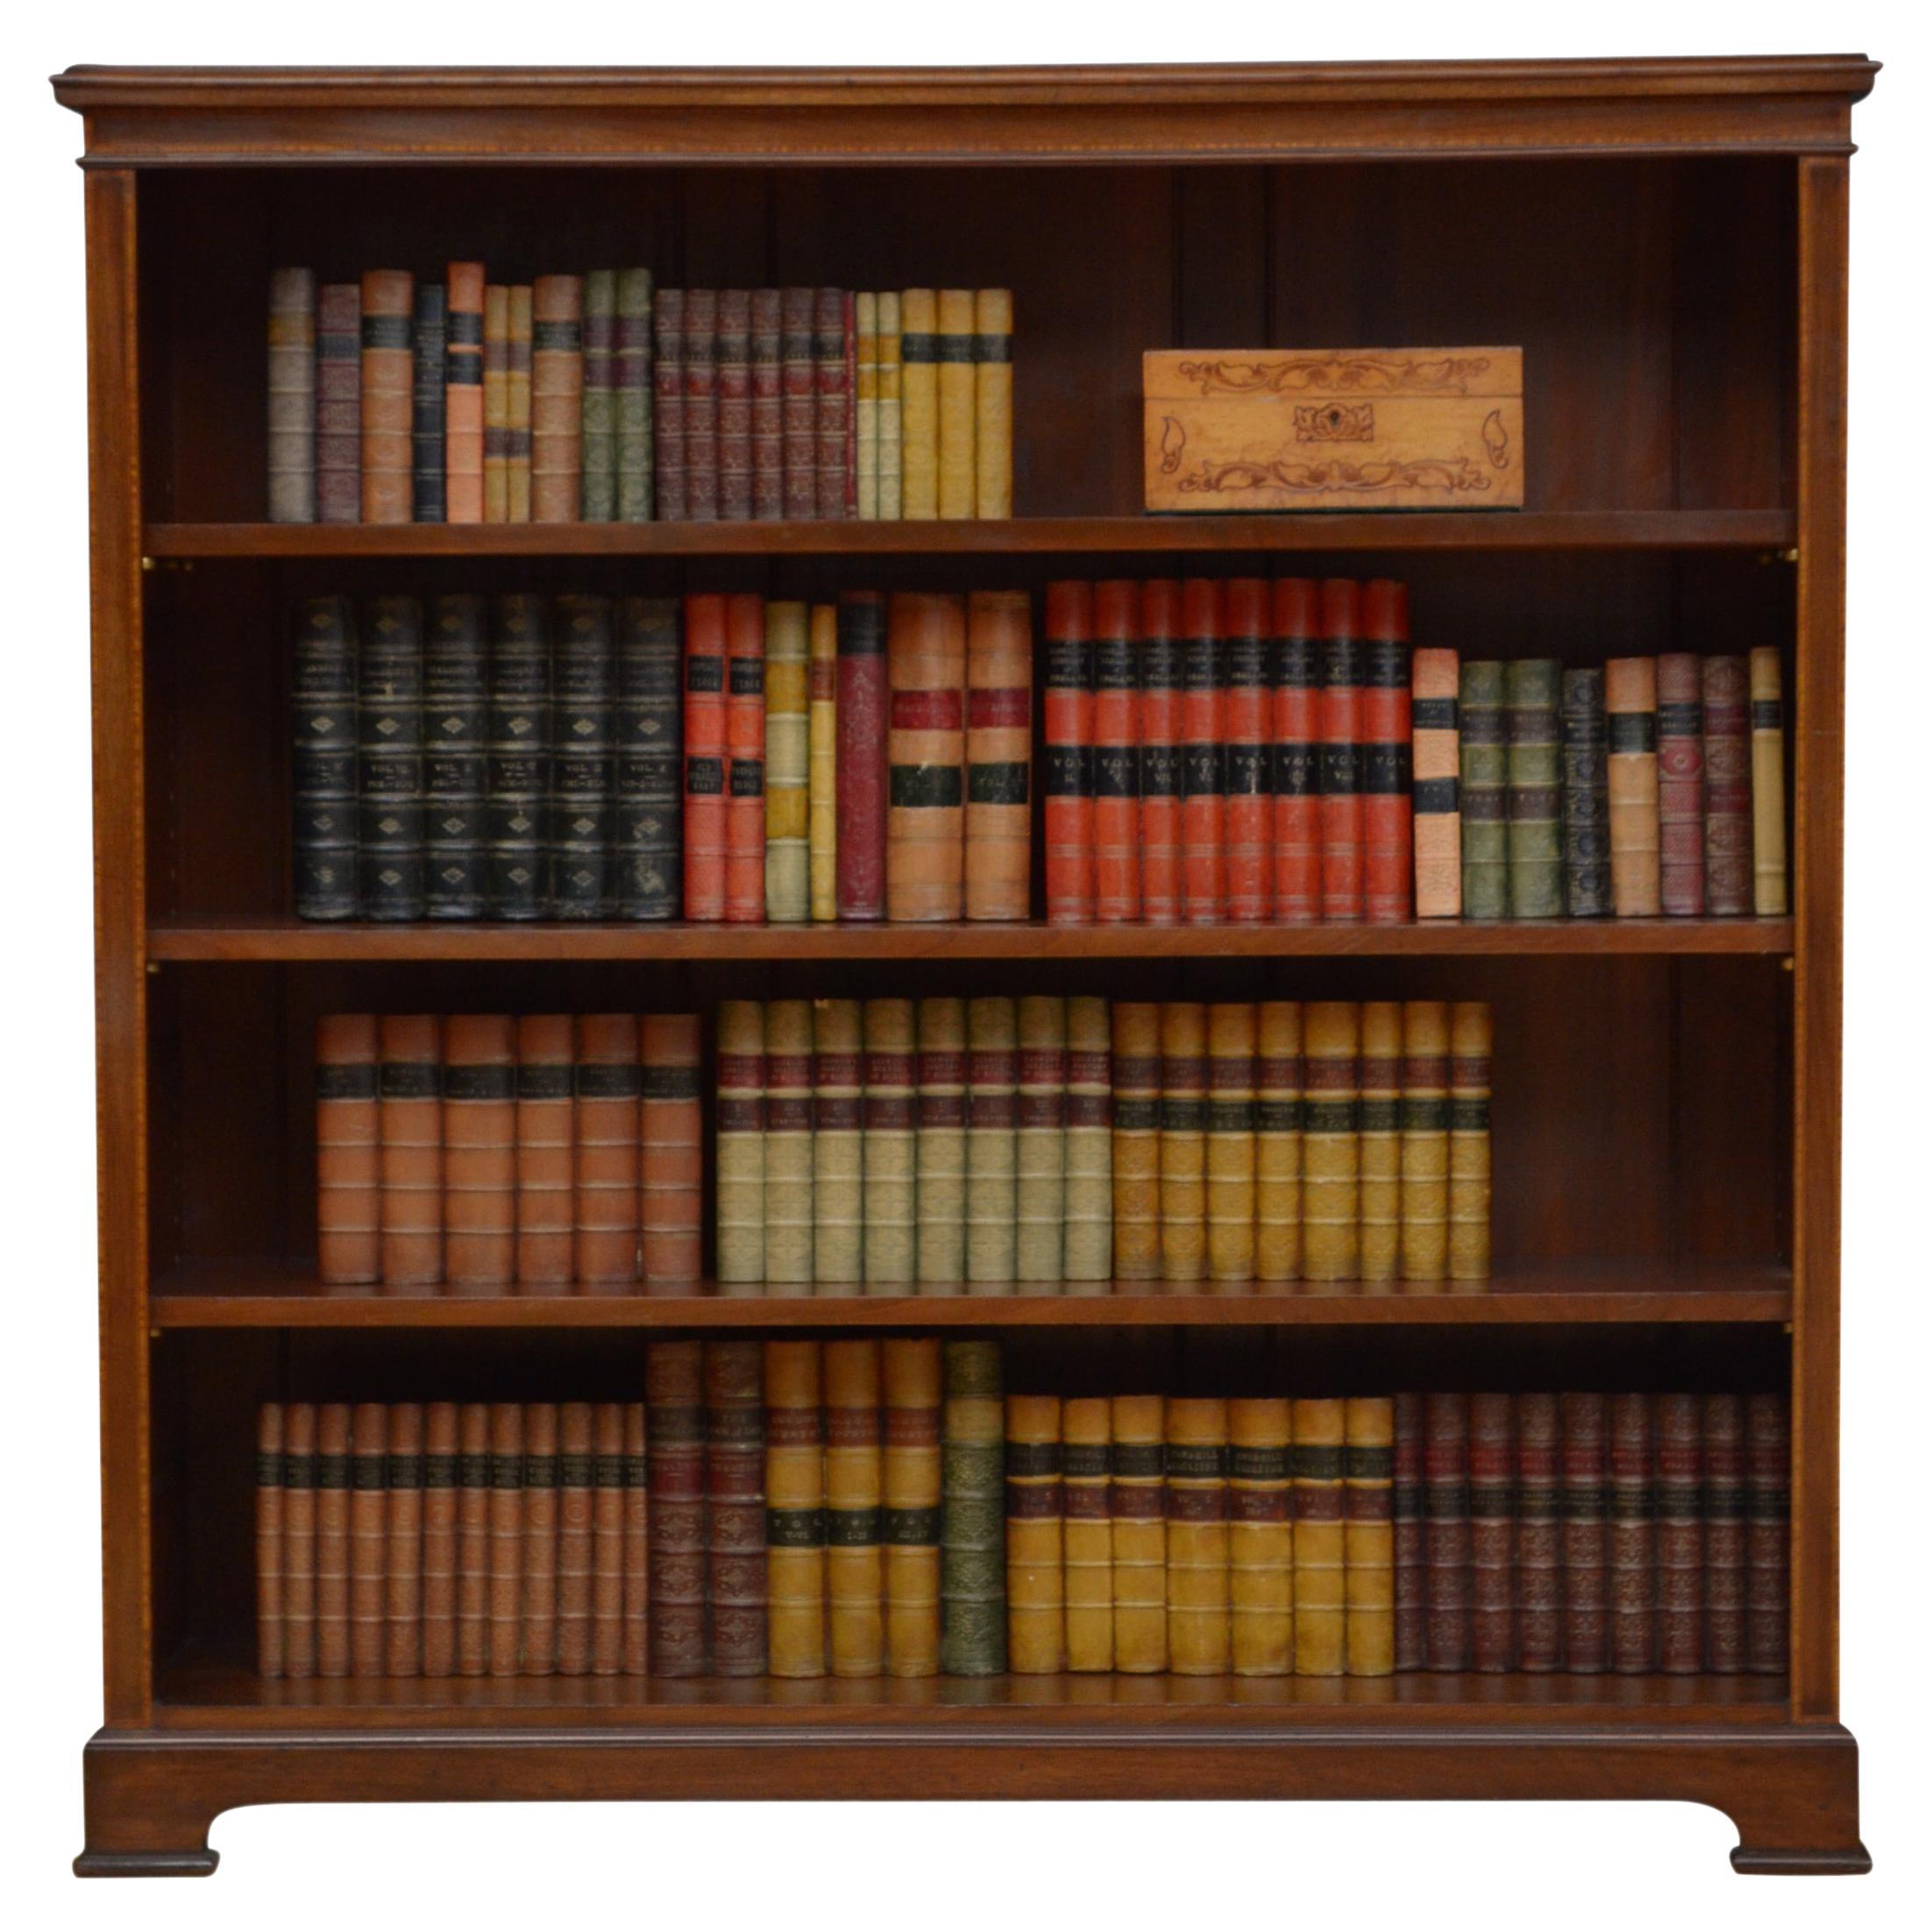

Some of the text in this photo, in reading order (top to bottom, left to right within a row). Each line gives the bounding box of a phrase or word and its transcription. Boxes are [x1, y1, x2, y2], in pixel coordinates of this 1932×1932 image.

[1054, 757, 1085, 769] VOL
[1101, 758, 1133, 768] VOL
[1146, 758, 1178, 769] VOL
[1189, 757, 1219, 767] VOL
[1282, 756, 1314, 766] VOL
[1327, 755, 1359, 766] VOL
[1375, 756, 1406, 766] VOL
